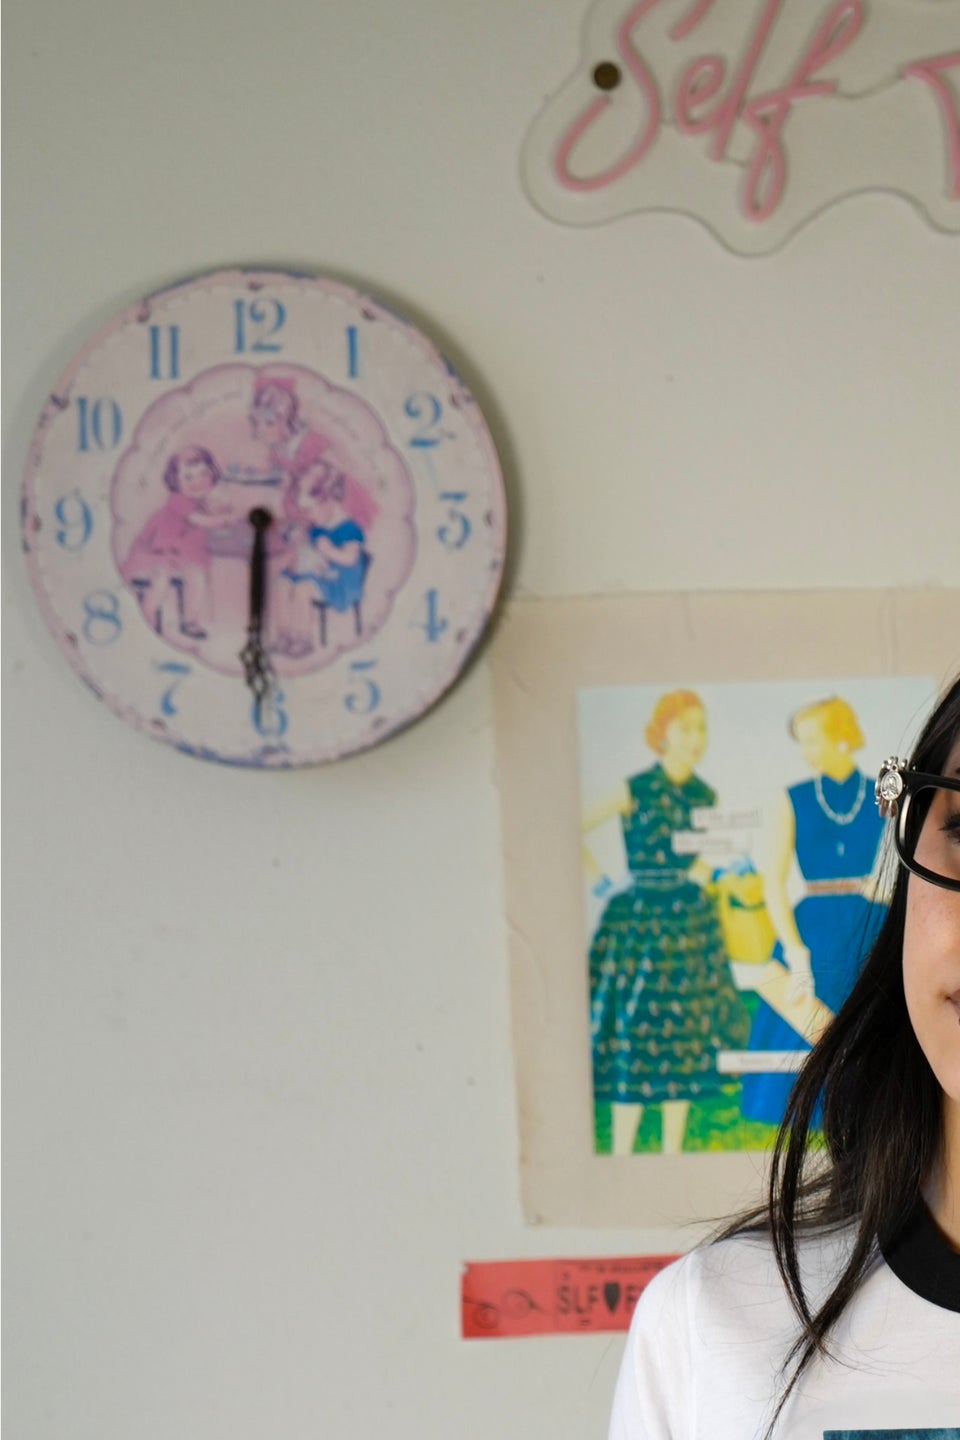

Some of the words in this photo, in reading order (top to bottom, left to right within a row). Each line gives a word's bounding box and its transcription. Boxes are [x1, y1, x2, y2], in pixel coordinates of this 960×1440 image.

[556, 0, 864, 221] Self
[149, 325, 179, 380] 11
[234, 298, 286, 353] 12
[345, 325, 359, 379] 1
[77, 396, 123, 452] 10
[404, 393, 443, 448] 2
[55, 496, 94, 552] 9
[437, 491, 472, 549] 3
[82, 588, 122, 645] 8
[408, 588, 448, 642] 4
[153, 658, 191, 717] 7
[250, 686, 290, 737] 6
[344, 659, 382, 716] 5
